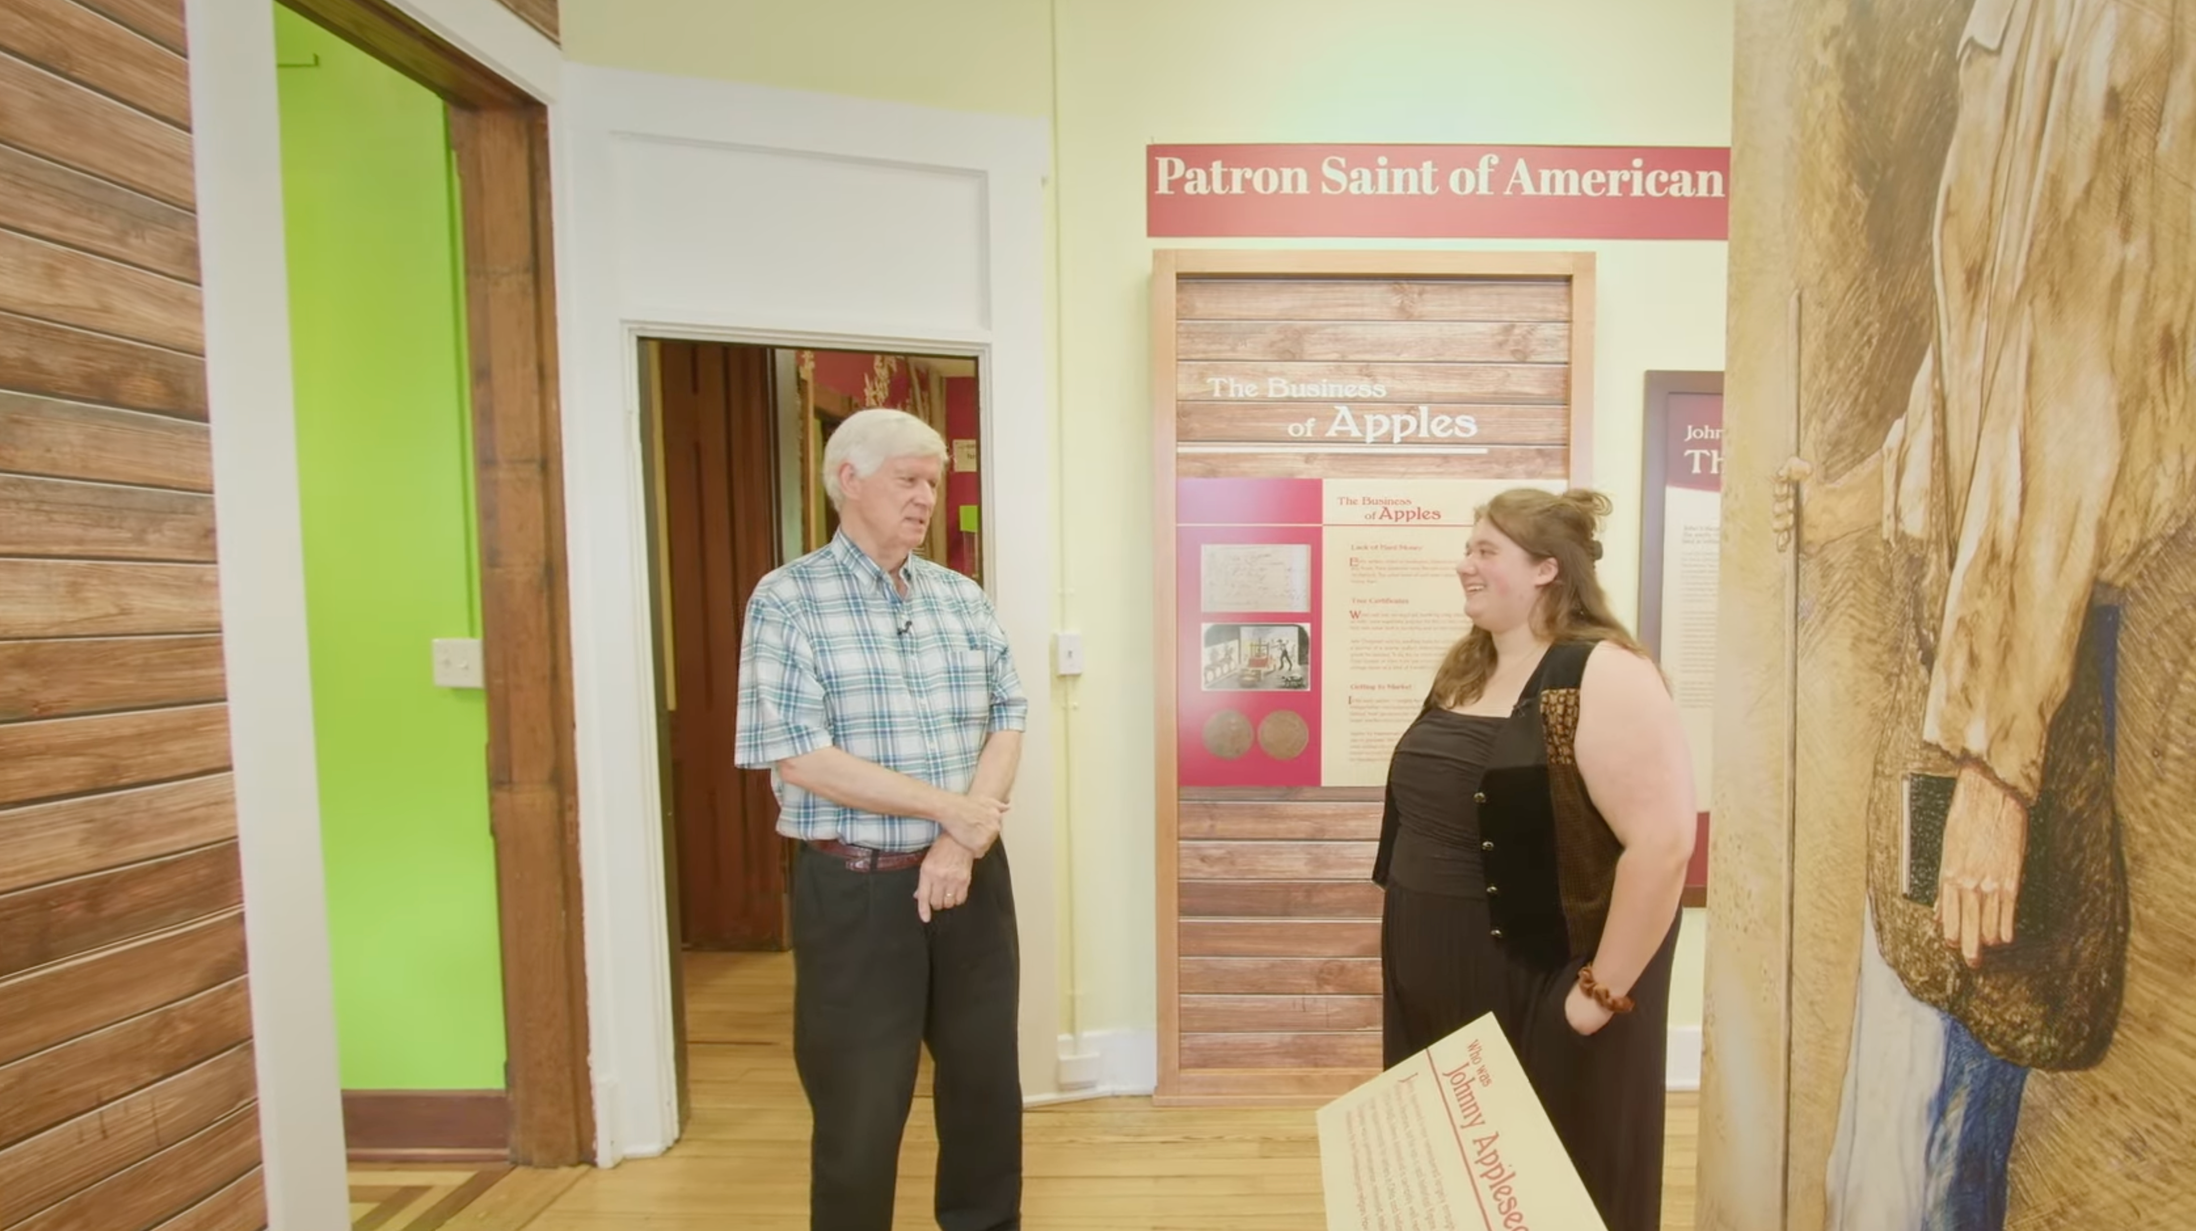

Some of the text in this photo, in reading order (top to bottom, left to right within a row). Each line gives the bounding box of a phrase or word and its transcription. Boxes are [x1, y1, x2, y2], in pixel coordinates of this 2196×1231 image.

[1154, 154, 1725, 198] Patron Saint of American
[1207, 377, 1387, 398] The Business
[1288, 405, 1478, 444] of Apples
[1337, 496, 1413, 506] The Business
[1364, 506, 1442, 523] of Apples
[1467, 1038, 1493, 1088] Who was
[1442, 1061, 1486, 1130] Johnny
